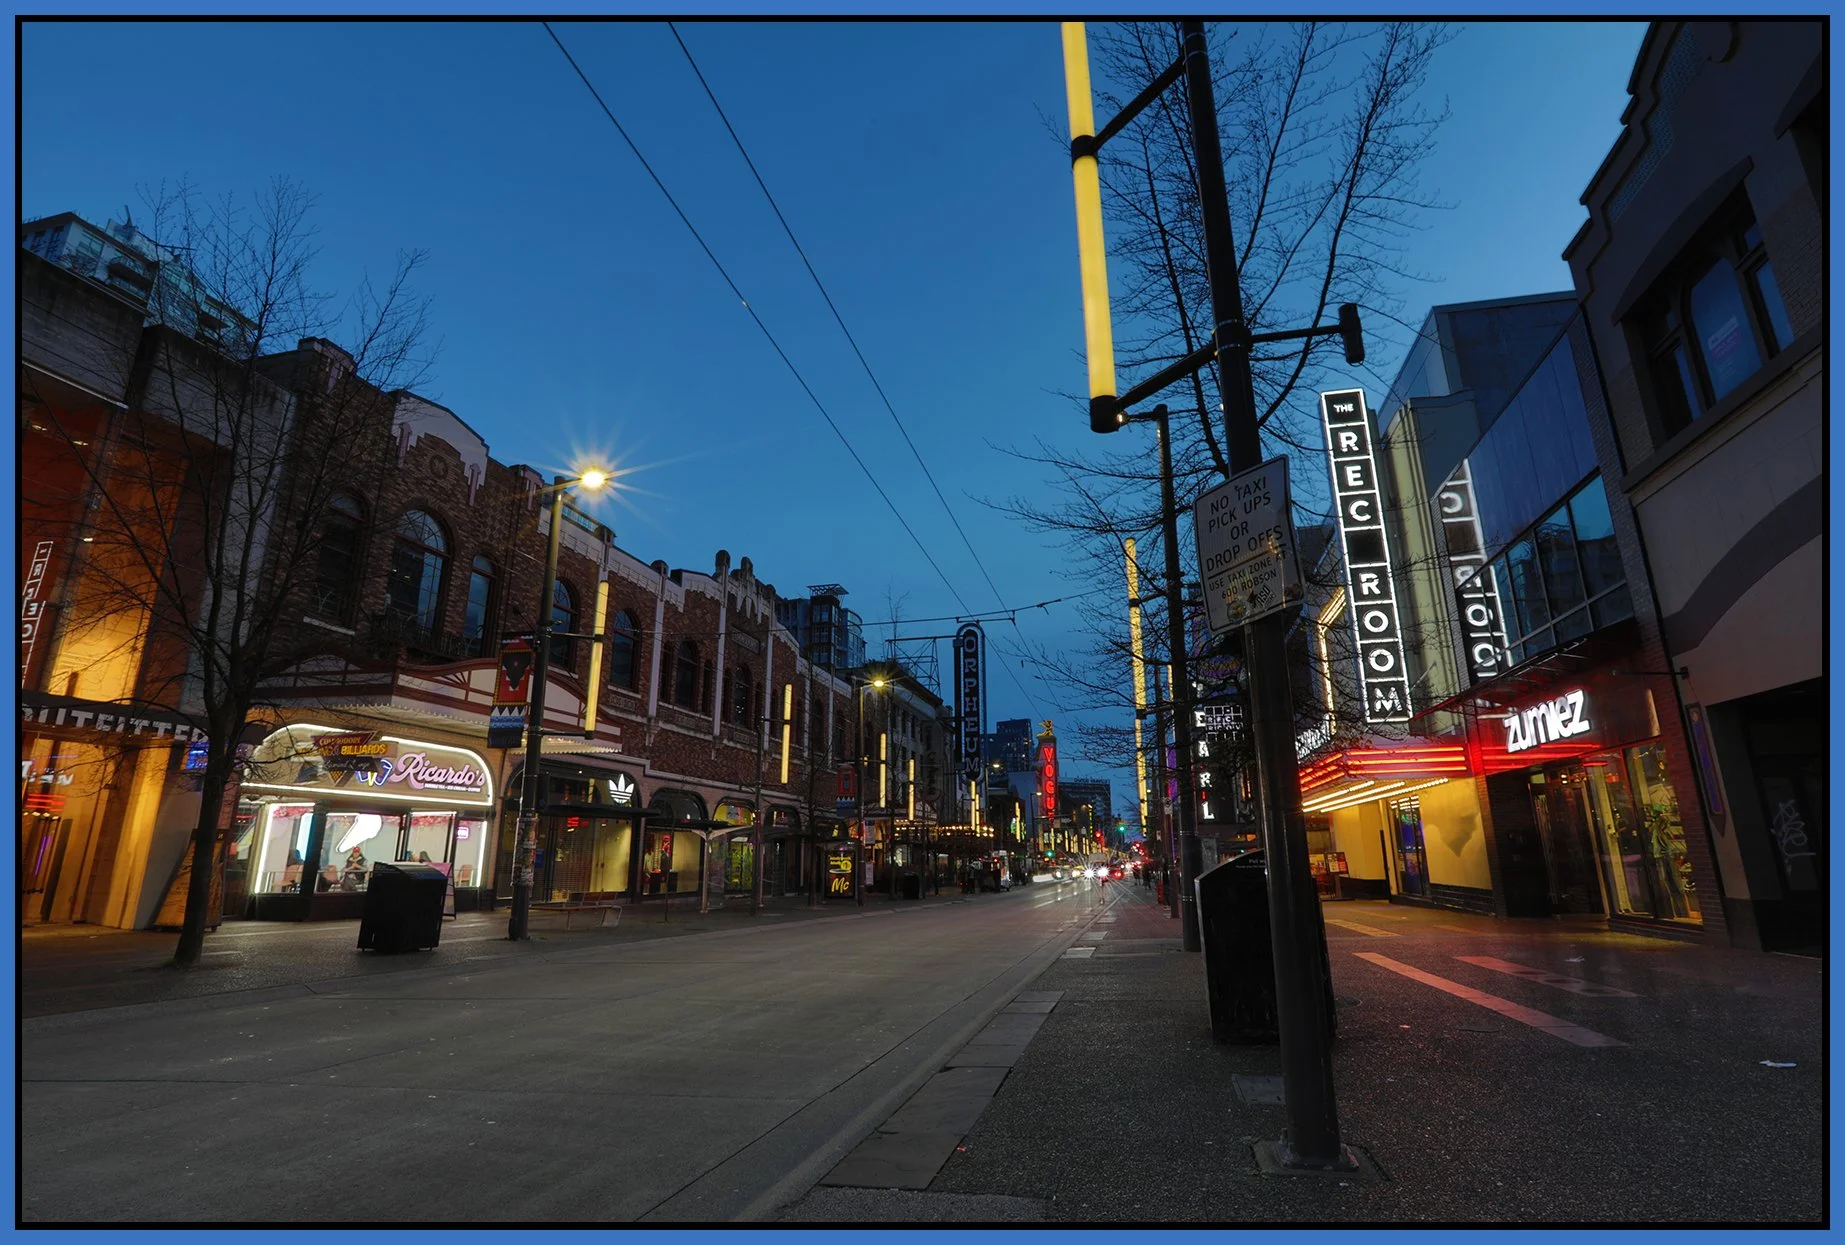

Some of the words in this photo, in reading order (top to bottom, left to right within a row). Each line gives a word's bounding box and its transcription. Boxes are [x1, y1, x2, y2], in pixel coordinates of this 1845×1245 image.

[1333, 402, 1355, 414] THE
[1210, 495, 1230, 516] NO
[1235, 475, 1267, 501] TAXI
[1339, 431, 1372, 522] REC
[1208, 508, 1237, 534] PICK
[1244, 491, 1272, 516] UPS
[1230, 521, 1250, 541] OR
[1205, 546, 1241, 573] DROP
[1247, 525, 1285, 553] OFFS
[1208, 576, 1225, 592] USE
[1226, 567, 1247, 584] TAXI
[1248, 556, 1273, 575] ZONE
[1221, 585, 1240, 600] 600
[1241, 568, 1278, 592] ROBSON
[1360, 571, 1403, 713] ROOM
[962, 635, 981, 774] ORPHEUM
[340, 743, 387, 755] BILLIARDS
[390, 751, 486, 790] Ricardo's
[1042, 746, 1056, 822] VOGUE
